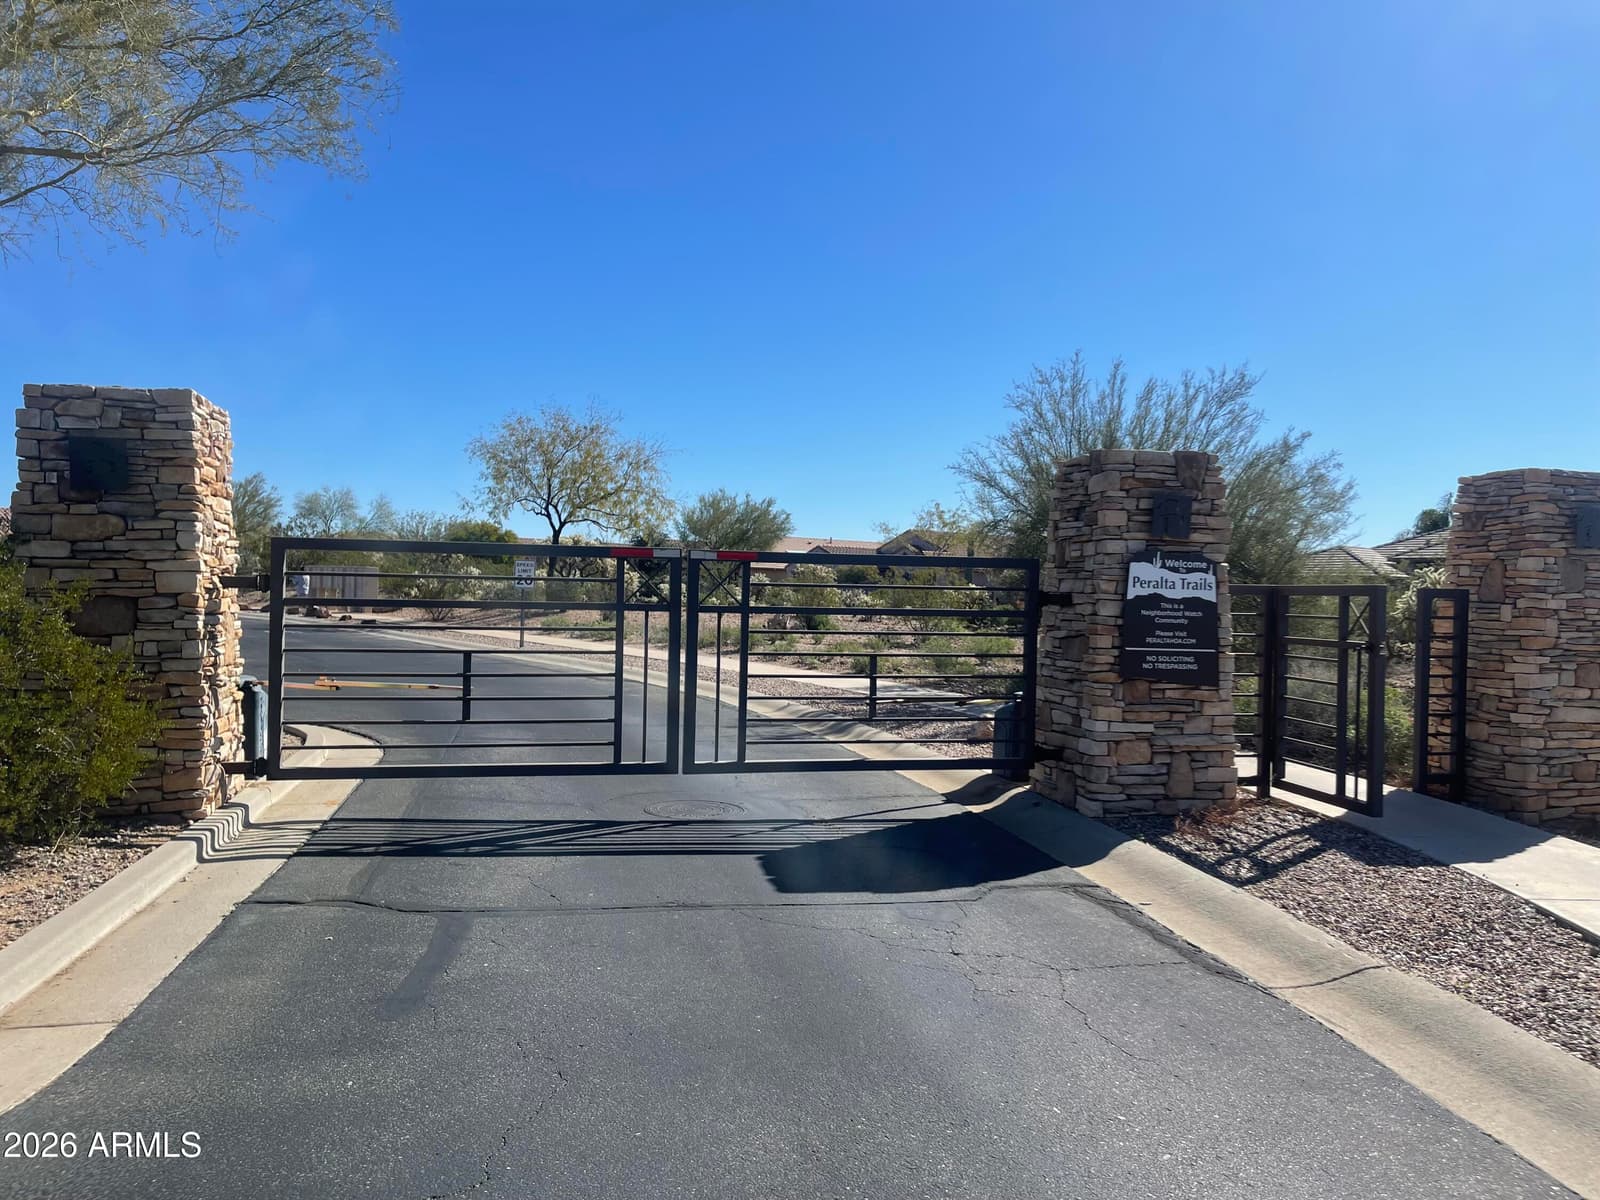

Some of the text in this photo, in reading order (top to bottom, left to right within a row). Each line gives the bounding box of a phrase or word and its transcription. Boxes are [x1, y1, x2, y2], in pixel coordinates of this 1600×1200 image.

[1165, 560, 1208, 569] Welcome
[1133, 576, 1214, 591] Peralta Trails
[1141, 609, 1183, 617] Neighborhood
[1154, 617, 1188, 625] Community
